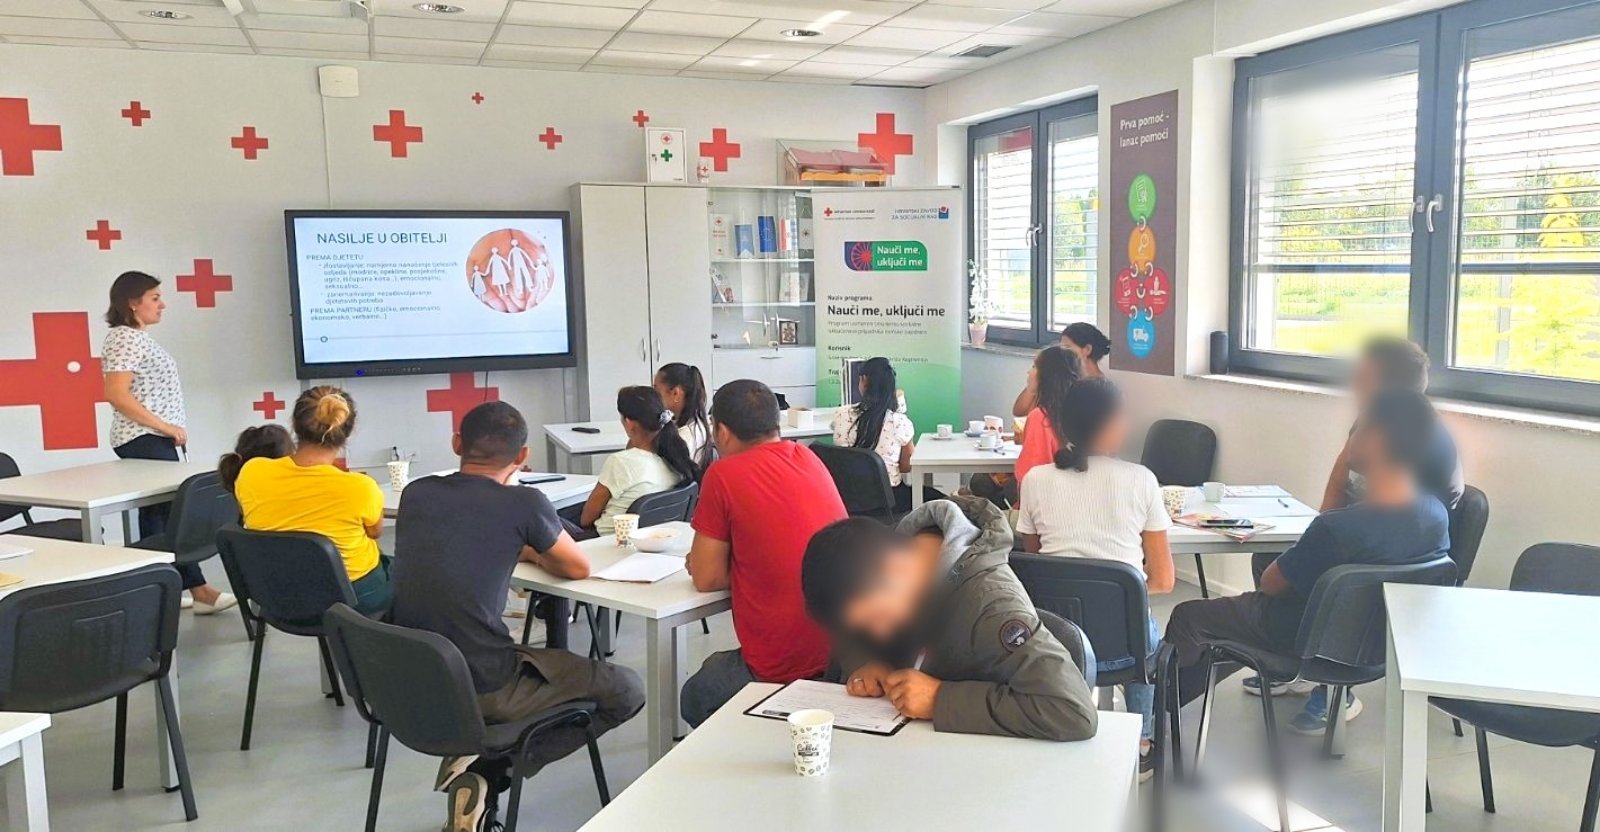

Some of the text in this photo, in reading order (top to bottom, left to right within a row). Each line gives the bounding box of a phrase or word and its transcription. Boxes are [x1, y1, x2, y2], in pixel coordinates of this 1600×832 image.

[1120, 119, 1137, 130] Prva
[1138, 109, 1164, 130] pomoć
[1120, 136, 1139, 148] lanac
[317, 232, 447, 244] NASILJE U OBITELJI
[877, 244, 921, 256] Nauči me,
[877, 257, 923, 268] uključi me
[828, 304, 945, 319] Nauči me, uključi me
